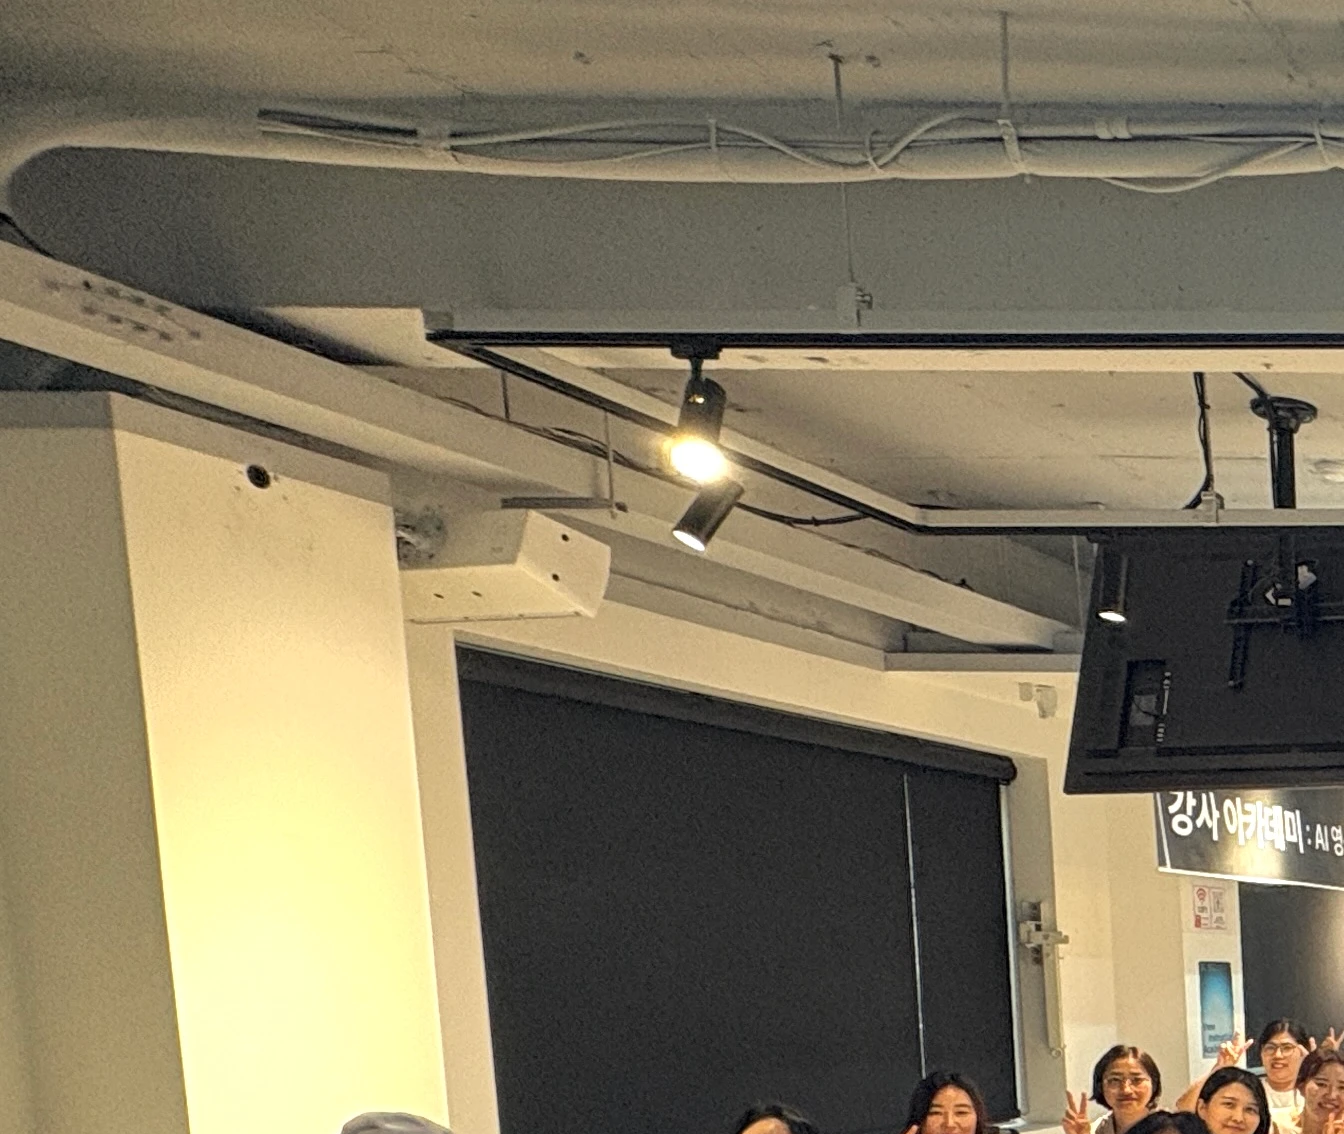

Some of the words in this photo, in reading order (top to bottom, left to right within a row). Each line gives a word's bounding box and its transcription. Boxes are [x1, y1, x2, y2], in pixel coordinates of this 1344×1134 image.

[1168, 791, 1220, 841] 강사
[1223, 797, 1304, 854] 아카데미
[1315, 824, 1329, 851] AI
